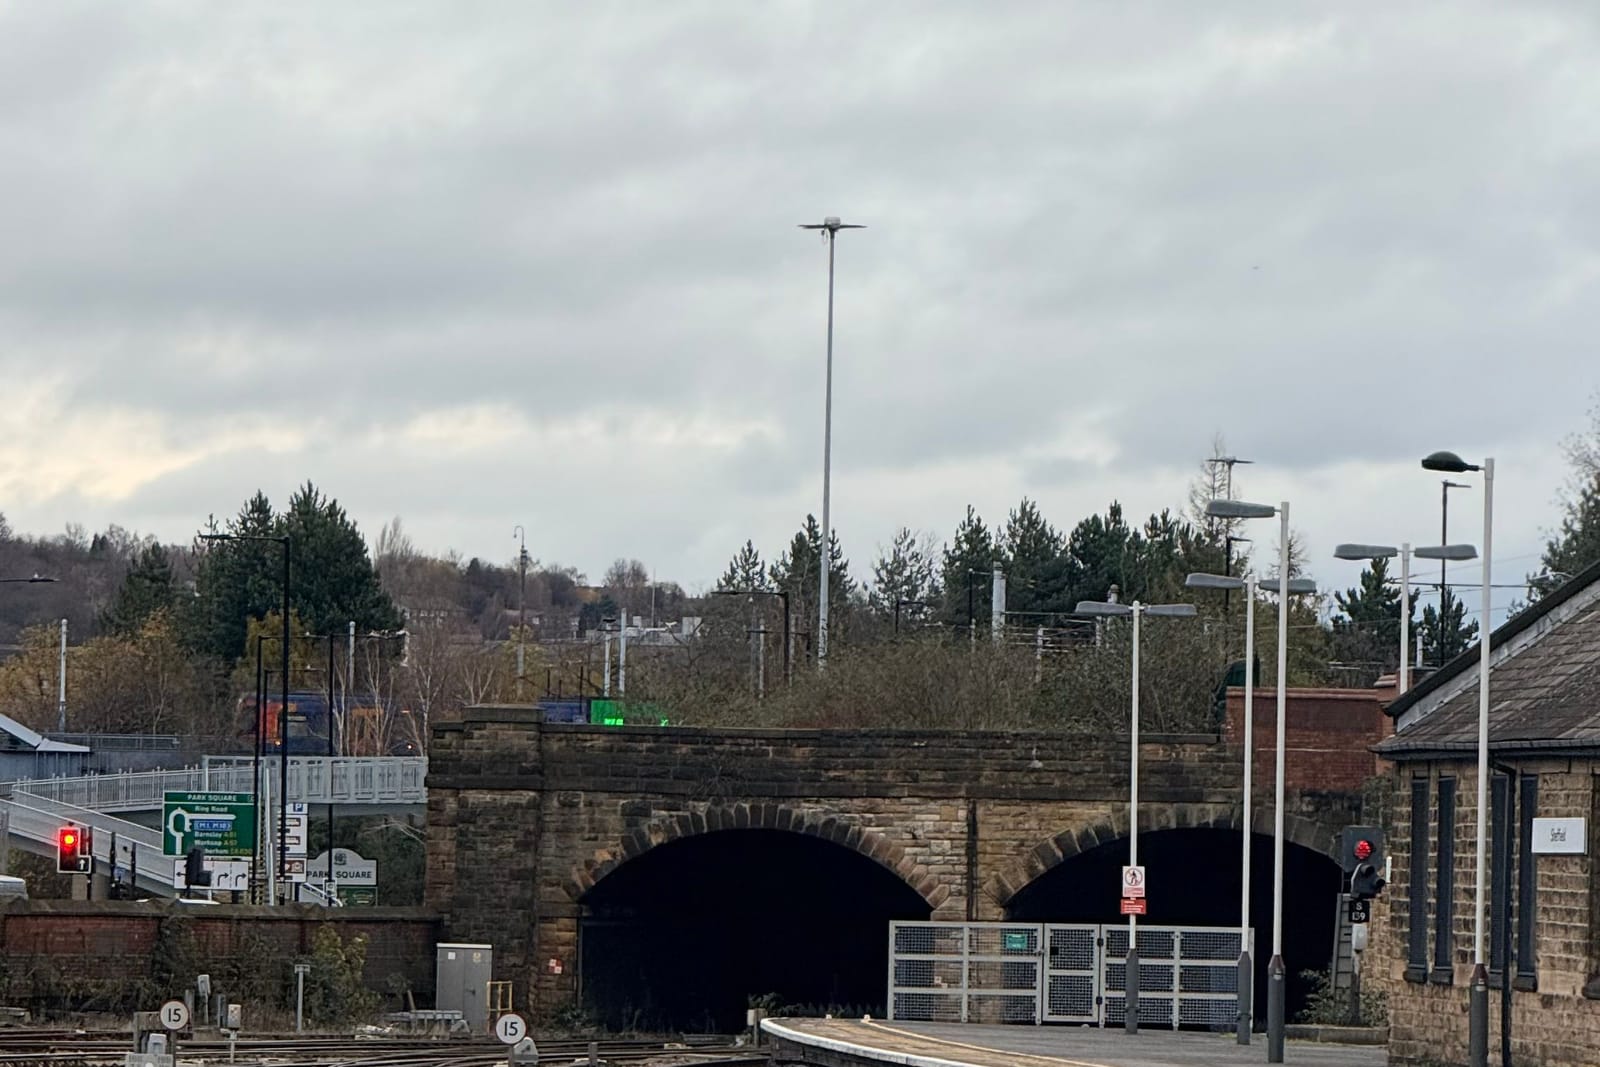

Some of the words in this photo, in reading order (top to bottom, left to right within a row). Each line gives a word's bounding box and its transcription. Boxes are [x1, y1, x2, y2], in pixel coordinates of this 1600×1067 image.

[187, 794, 206, 802] PARK
[208, 794, 237, 802] SQUARE
[336, 871, 372, 879] SQUARE
[168, 1008, 182, 1023] 15
[504, 1021, 519, 1037] 15
